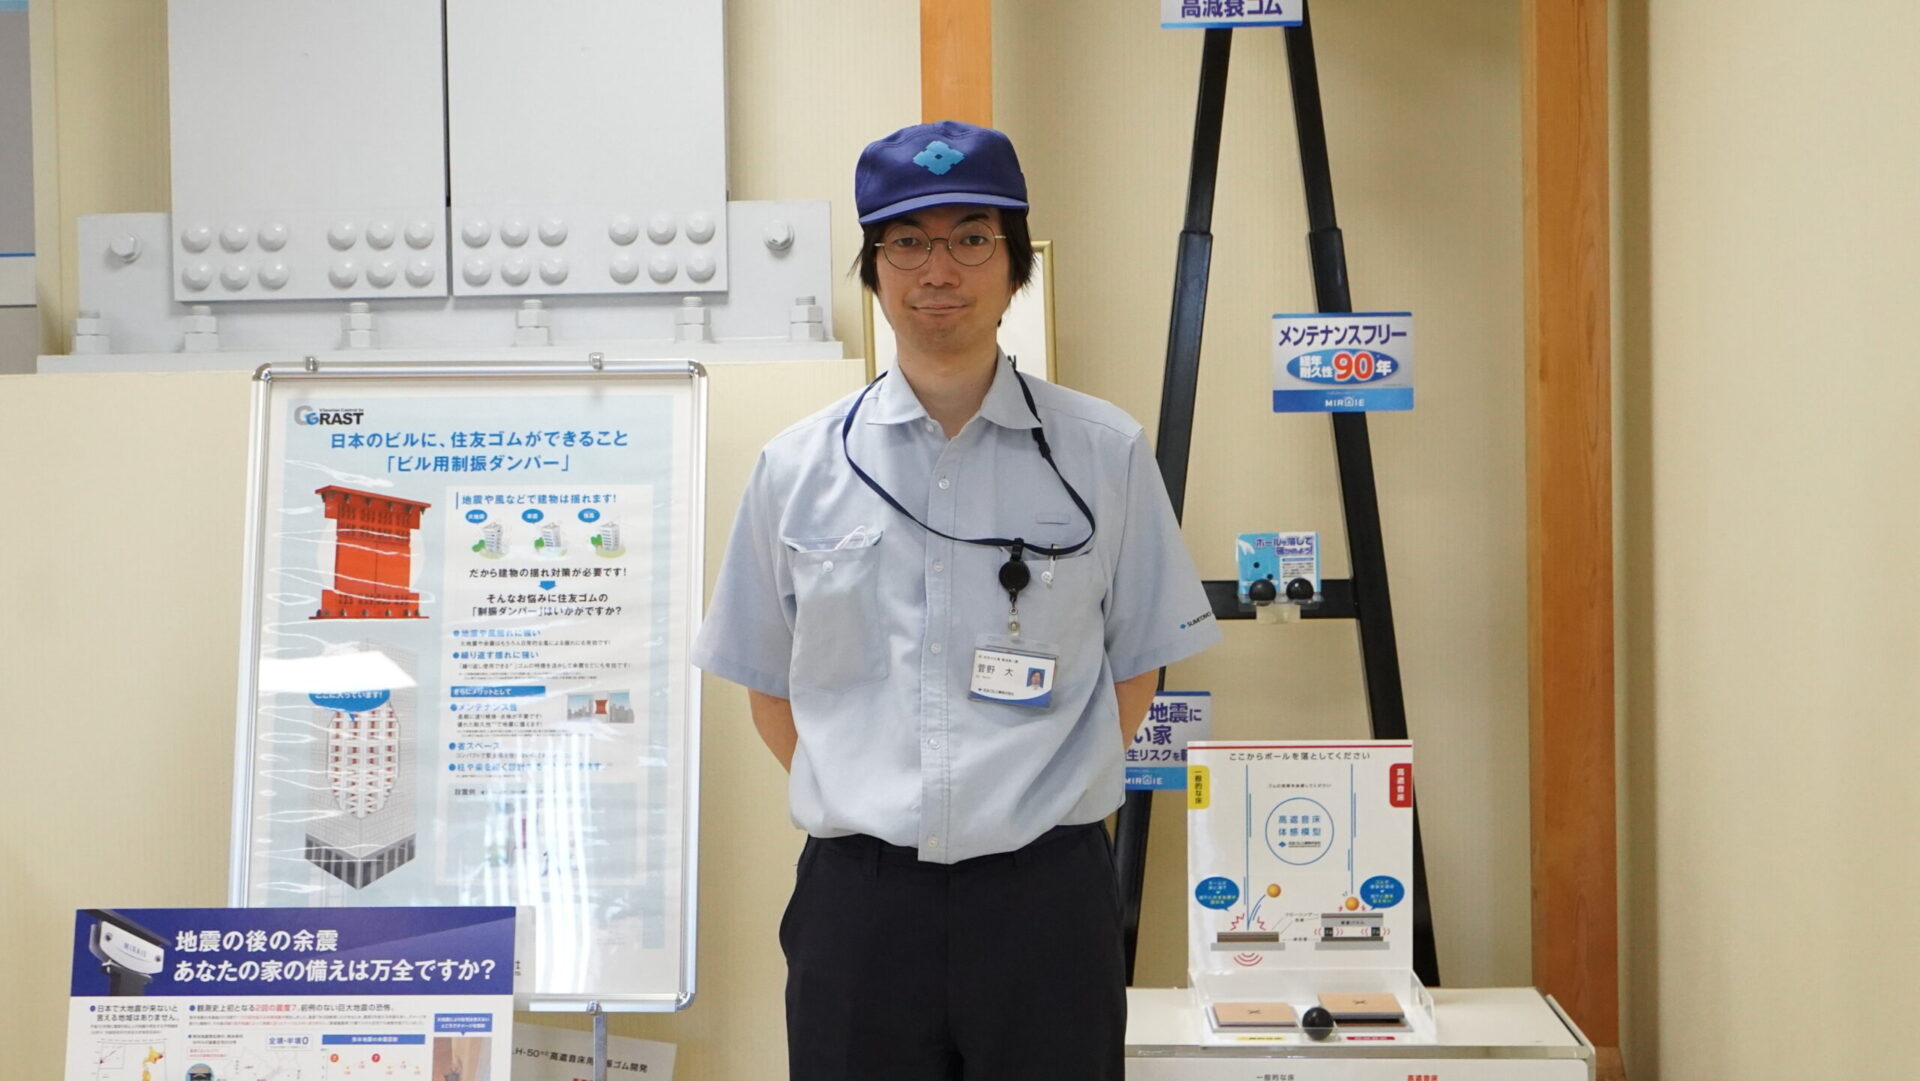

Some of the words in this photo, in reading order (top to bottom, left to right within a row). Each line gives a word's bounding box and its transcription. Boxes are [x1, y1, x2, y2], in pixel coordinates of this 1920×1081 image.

[1278, 324, 1407, 346] メンテナンスフリー
[1300, 366, 1333, 378] 耐久性
[1332, 351, 1375, 381] 90
[1376, 360, 1392, 376] 年
[331, 430, 629, 449] 日本のビルに、住友ゴムができること
[387, 455, 570, 473] 「ビル用制振ダンパー」
[486, 594, 608, 603] そんなお悩みに住友ゴムの
[1149, 702, 1202, 723] 地震に
[1229, 752, 1371, 761] ここからボールを落としてください
[174, 930, 338, 952] 地震の後の余震
[173, 959, 496, 982] あなたの家の備えは万全ですか?
